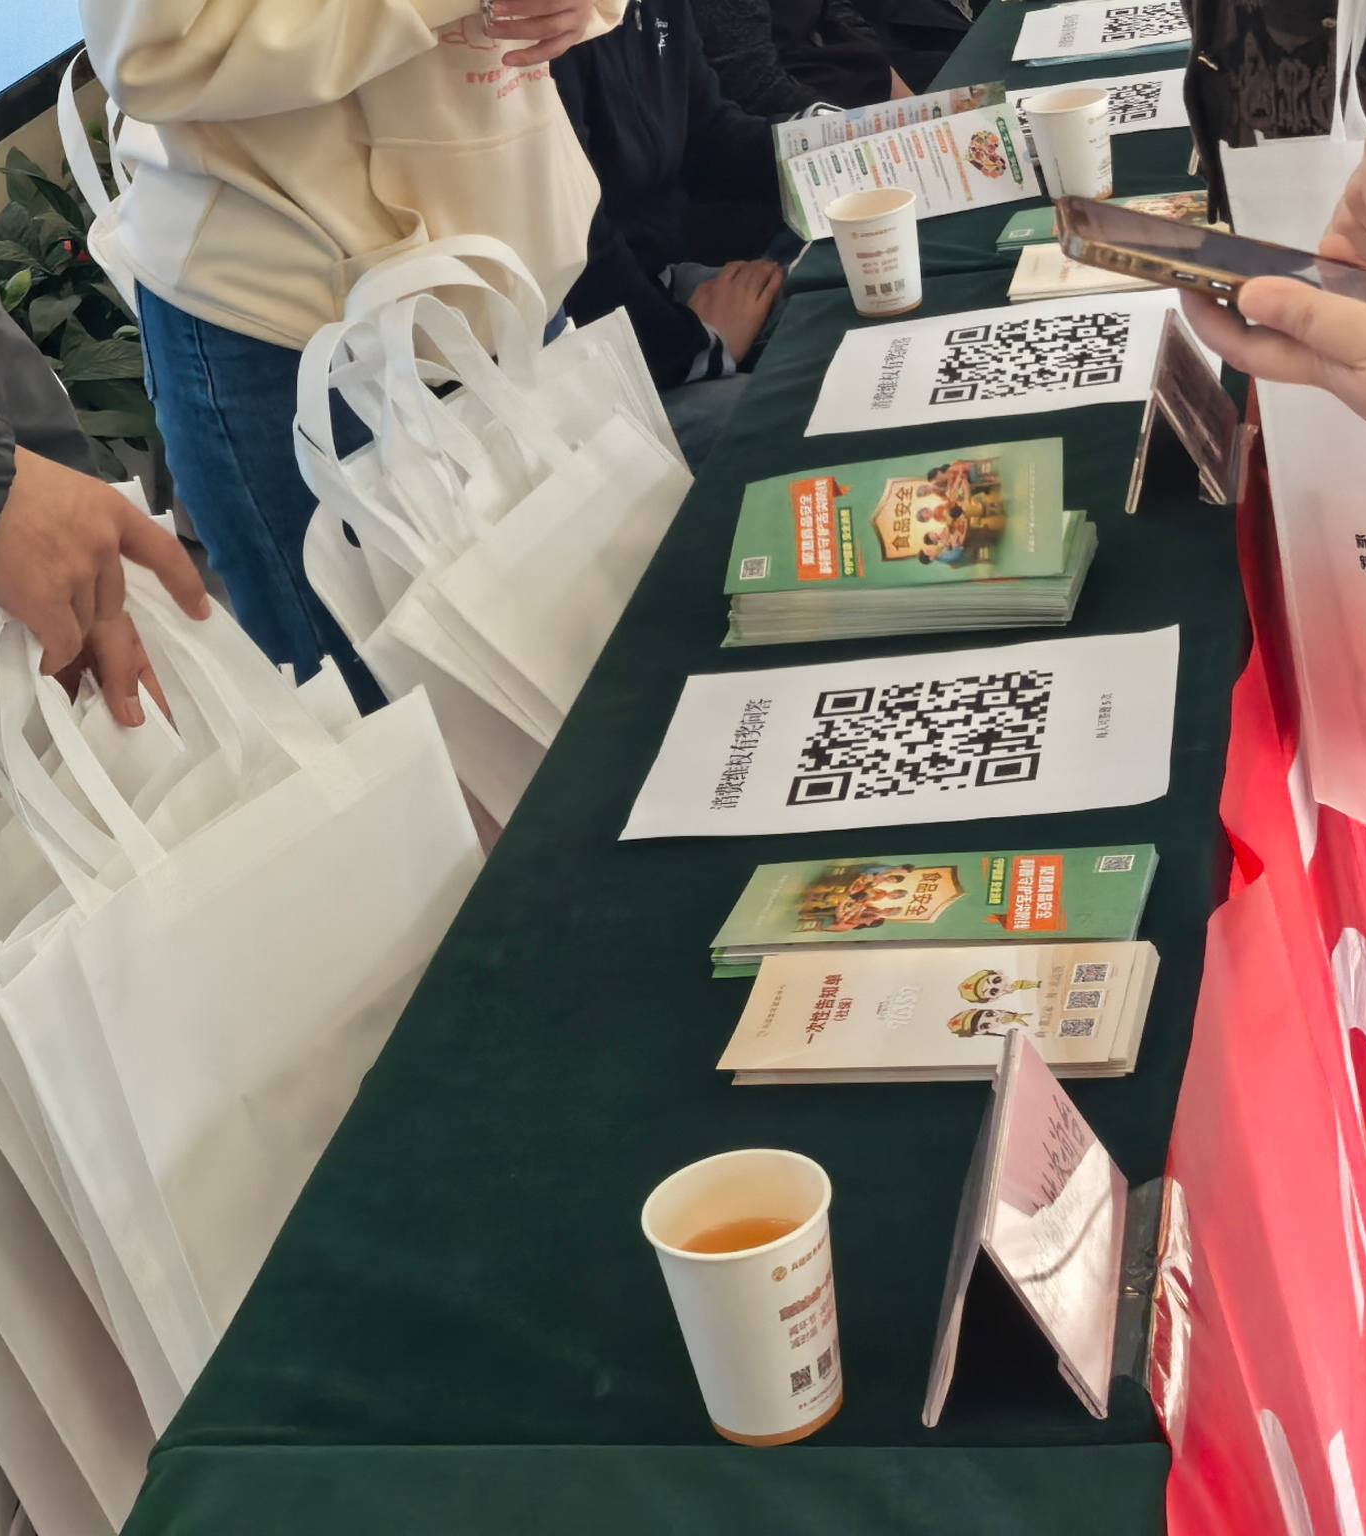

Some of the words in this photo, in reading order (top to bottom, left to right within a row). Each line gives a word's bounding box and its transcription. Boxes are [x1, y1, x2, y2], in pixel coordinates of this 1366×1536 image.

[891, 485, 915, 551] 食品安全
[709, 697, 773, 811] 消费维权有奖问答
[903, 871, 941, 919] 食品安全
[806, 974, 843, 1045] 一次性告知单
